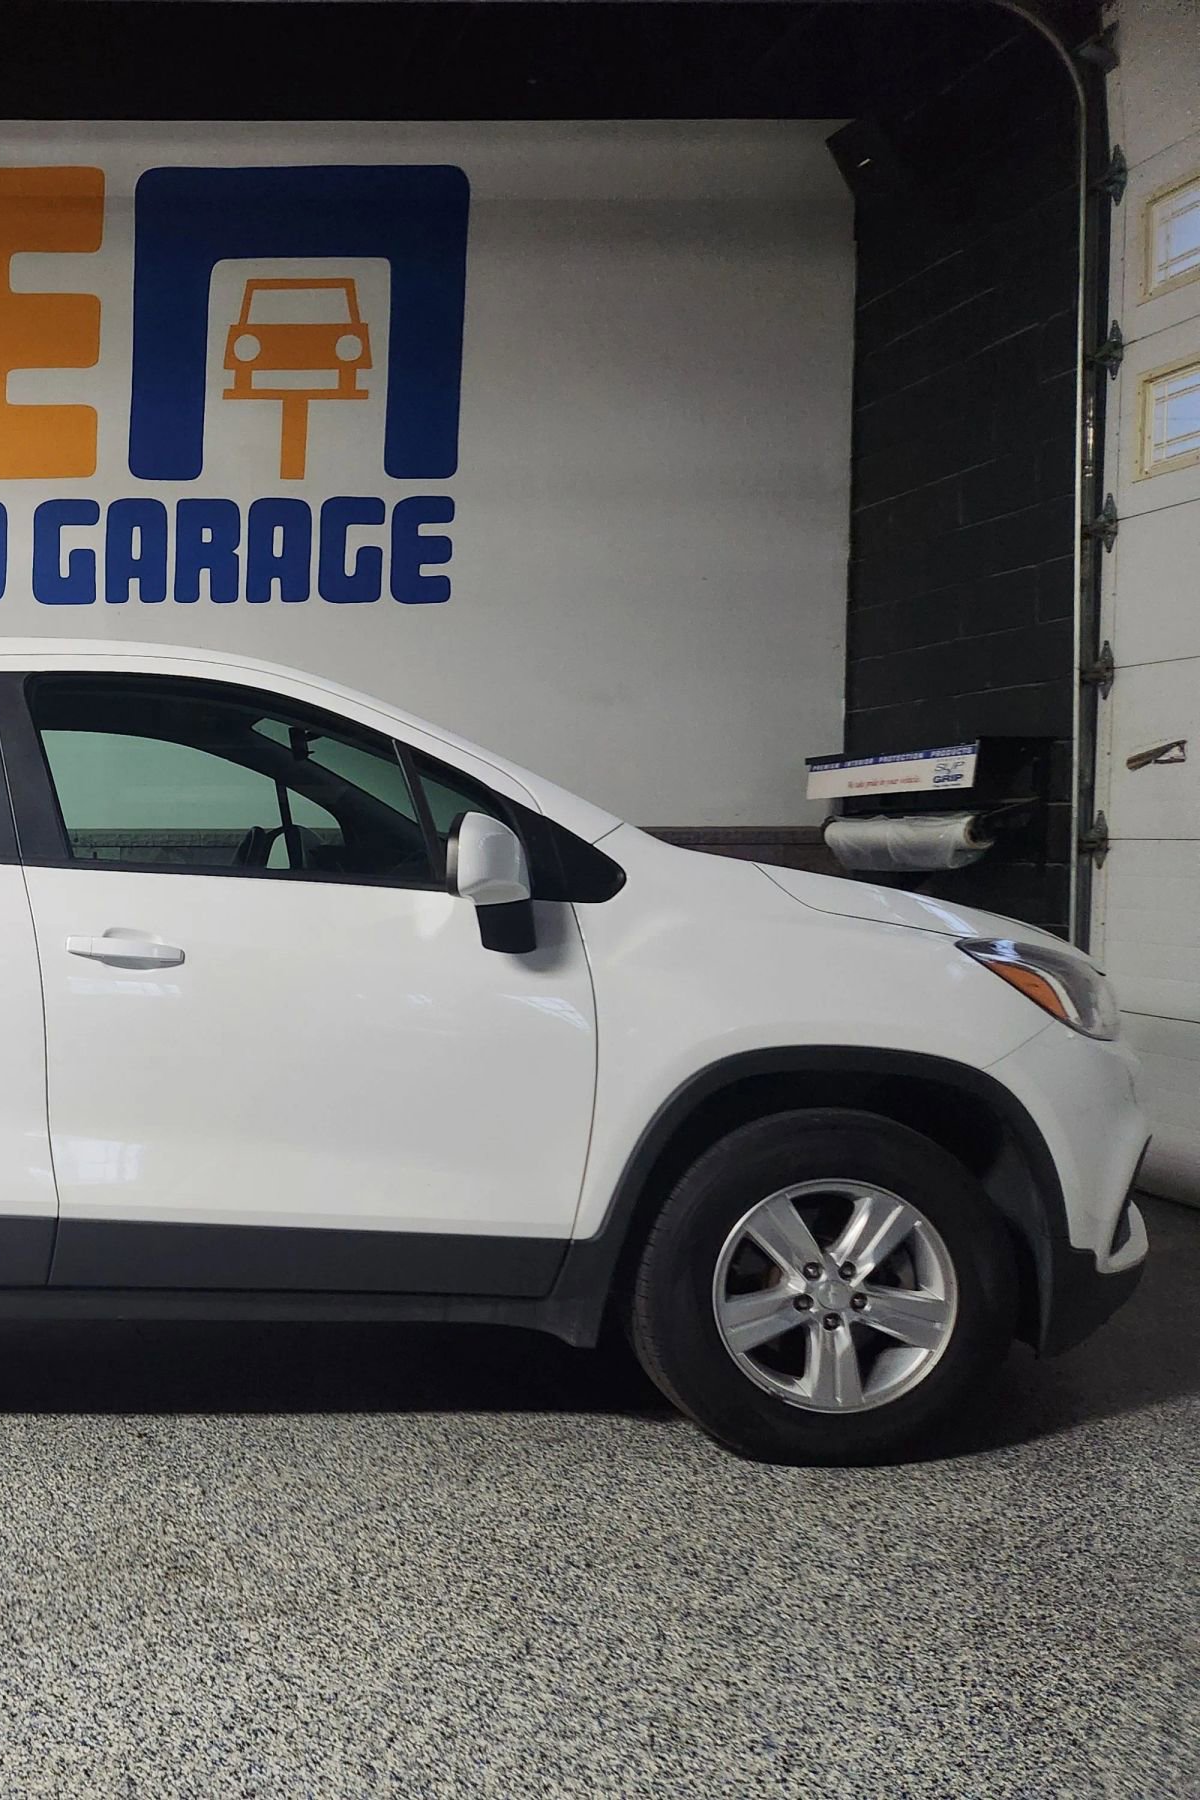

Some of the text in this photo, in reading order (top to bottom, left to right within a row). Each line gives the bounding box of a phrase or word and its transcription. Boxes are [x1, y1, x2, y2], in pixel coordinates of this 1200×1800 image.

[31, 496, 455, 605] GARAGE
[844, 758, 874, 767] INTERIOR
[879, 752, 924, 763] PROTECTION
[930, 746, 973, 757] PRODUCTS
[933, 773, 964, 783] GRIP
